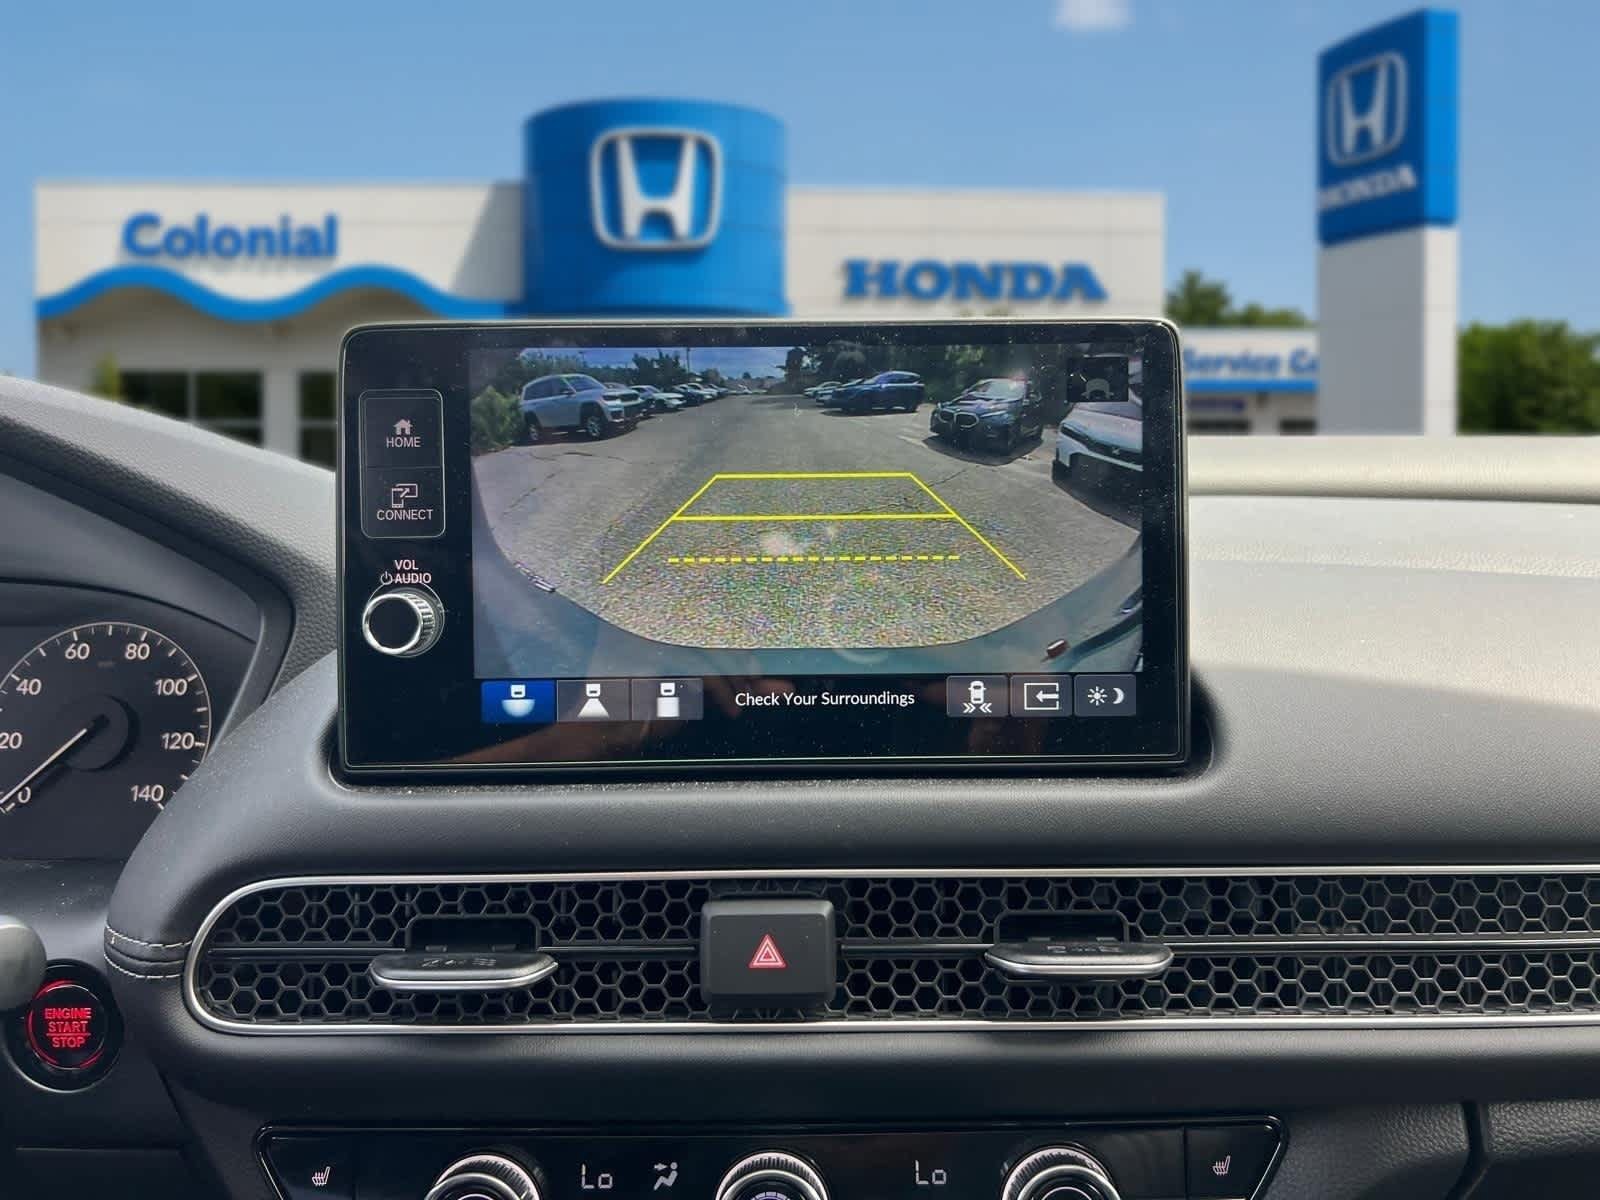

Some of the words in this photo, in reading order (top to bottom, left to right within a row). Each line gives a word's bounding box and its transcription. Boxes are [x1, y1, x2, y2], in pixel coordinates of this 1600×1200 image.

[1317, 165, 1417, 211] HONDA
[121, 211, 337, 259] Colonial
[842, 258, 1108, 304] HONDA
[386, 436, 421, 448] HOME
[376, 509, 433, 521] CONNECT
[394, 559, 419, 571] VOL
[394, 572, 432, 585] AUDIO
[65, 643, 90, 660] 60
[124, 643, 150, 660] 80
[16, 678, 42, 695] 40
[155, 678, 188, 696] 100
[735, 692, 780, 706] Check
[783, 692, 817, 706] Your
[821, 691, 915, 707] Surroundings
[0, 732, 22, 749] 20
[162, 732, 195, 750] 120
[17, 786, 31, 804] 0
[130, 784, 165, 802] 140
[44, 1007, 92, 1019] ENGINE
[48, 1021, 89, 1033] START
[52, 1036, 86, 1048] STOP
